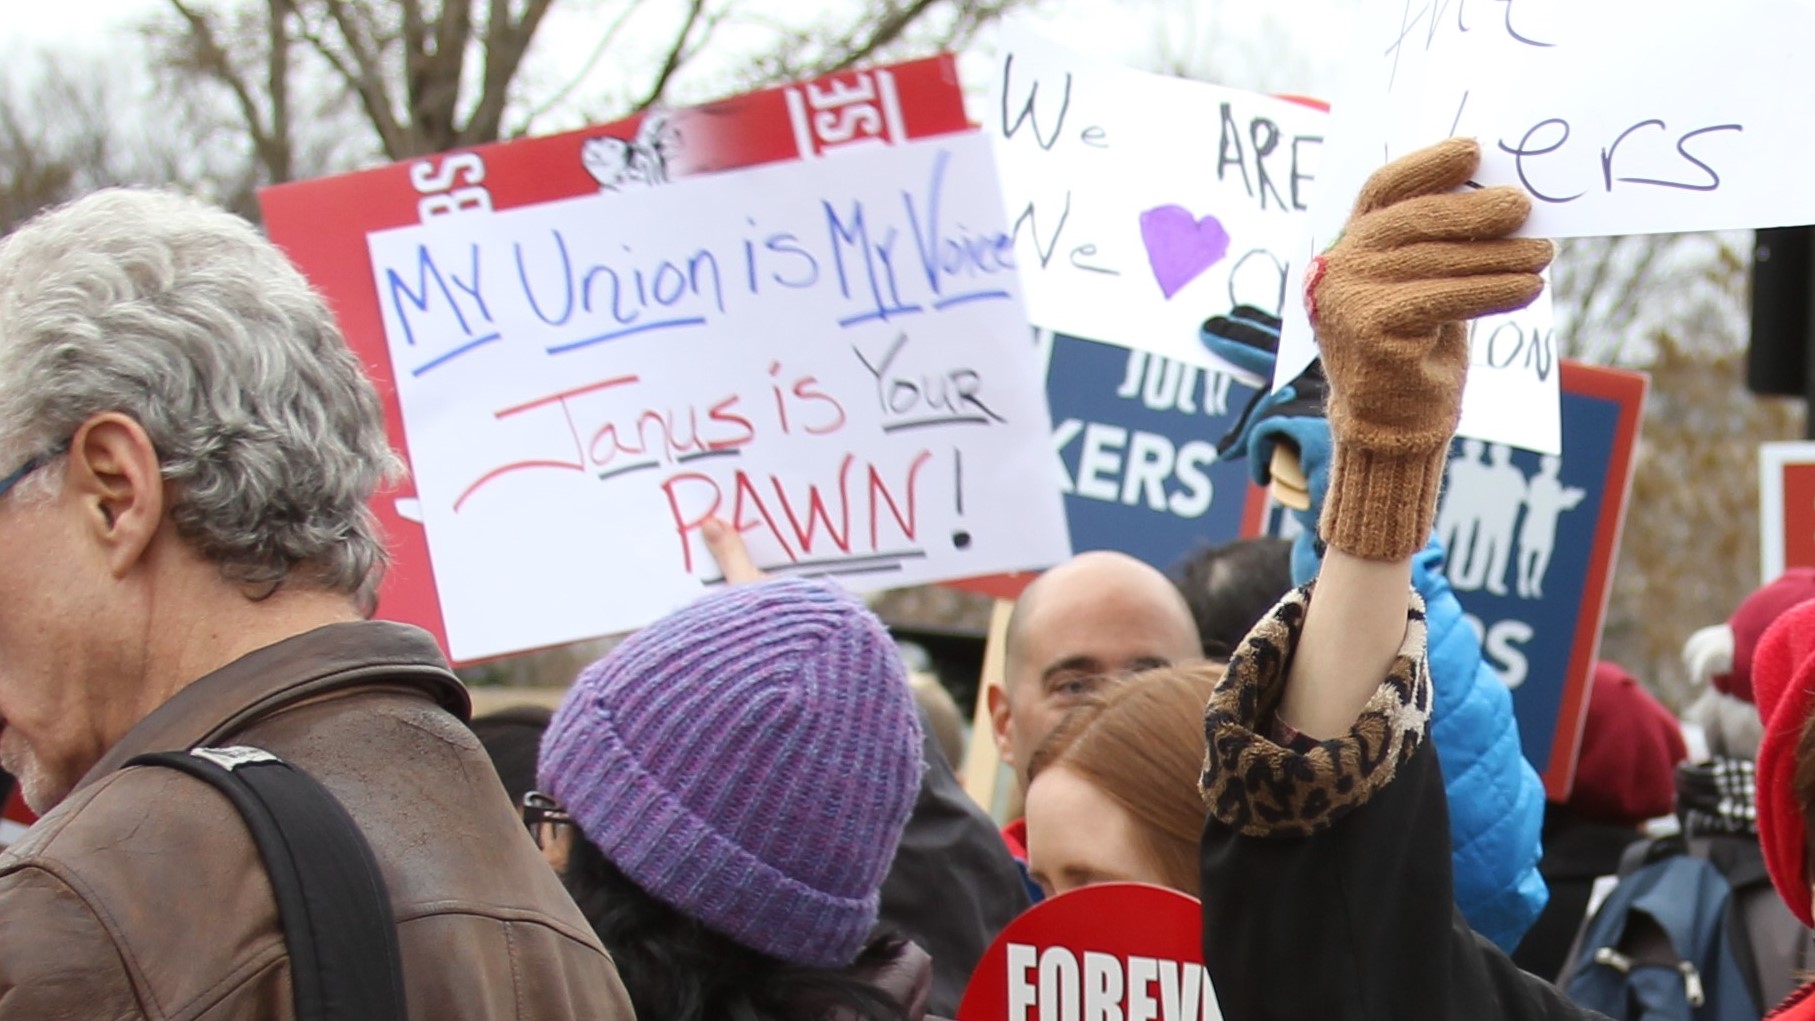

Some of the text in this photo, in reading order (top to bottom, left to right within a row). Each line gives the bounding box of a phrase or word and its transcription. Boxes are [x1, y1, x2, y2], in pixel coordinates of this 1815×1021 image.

[1001, 53, 1324, 213] We ARE
[1449, 90, 1743, 203] ers
[514, 229, 725, 327] Union
[743, 216, 820, 294] is
[900, 147, 1016, 294] Voice
[453, 373, 756, 513] Janus
[768, 360, 847, 437] is
[661, 446, 973, 574] PAWN!
